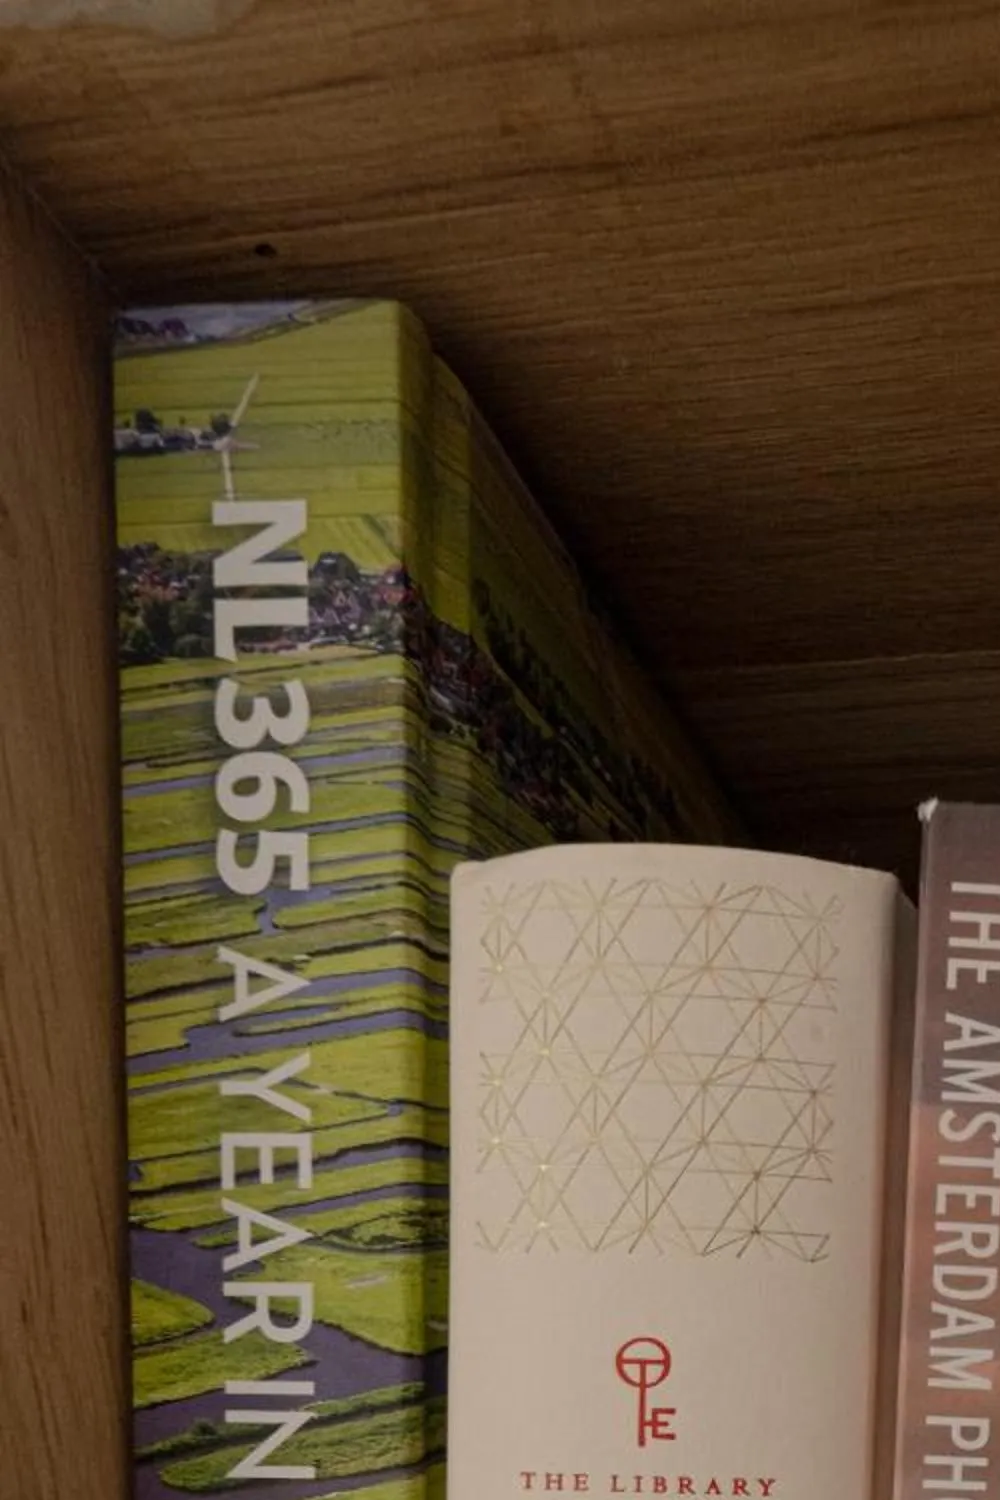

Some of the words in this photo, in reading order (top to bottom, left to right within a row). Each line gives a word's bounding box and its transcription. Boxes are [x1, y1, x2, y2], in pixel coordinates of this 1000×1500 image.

[210, 498, 311, 897] NL365
[218, 944, 312, 1022] A
[218, 1051, 315, 1345] YEAR
[222, 1379, 317, 1483] IN
[520, 1472, 590, 1492] THE
[610, 1474, 777, 1498] LIBRARY
